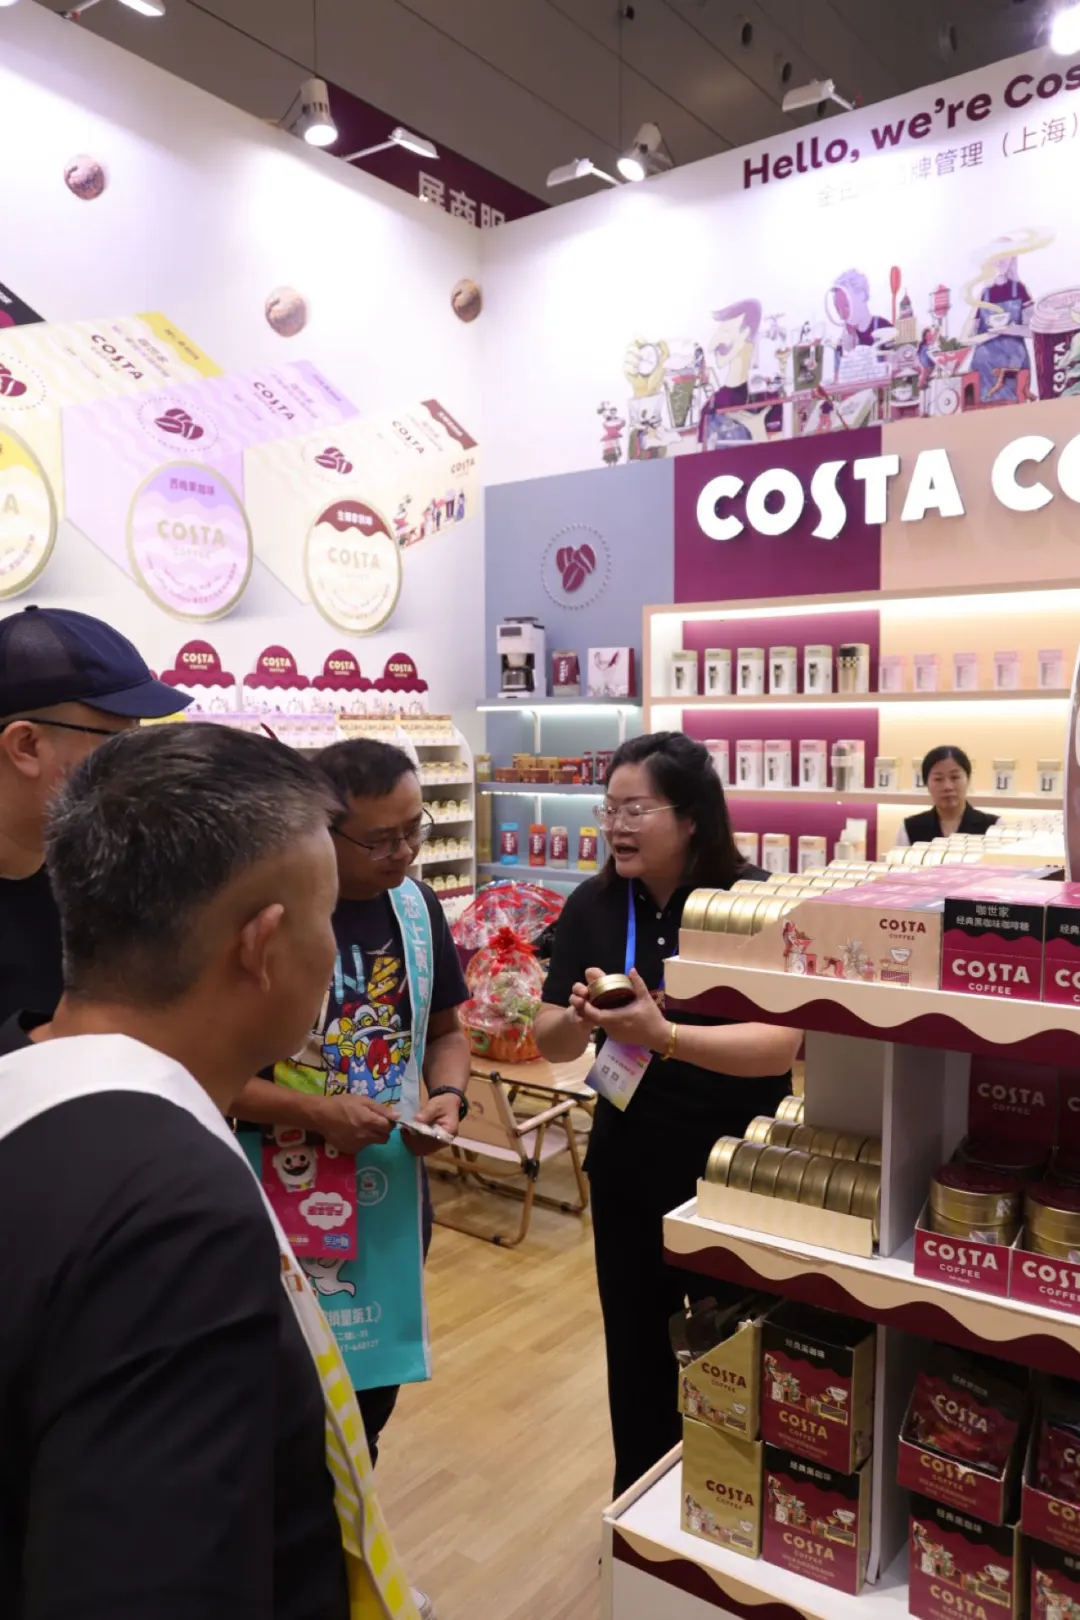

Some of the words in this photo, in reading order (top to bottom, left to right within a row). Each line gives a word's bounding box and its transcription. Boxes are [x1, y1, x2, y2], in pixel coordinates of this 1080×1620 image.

[743, 135, 860, 190] Hello,
[871, 92, 992, 150] we're
[91, 333, 144, 381] COSTA
[253, 381, 295, 421] COSTA
[696, 447, 966, 541] COSTA
[157, 519, 226, 549] COSTA
[328, 546, 382, 570] COSTA
[183, 651, 215, 665] COSTA
[262, 655, 292, 669] COSTA
[328, 659, 355, 672] COSTA
[388, 662, 413, 674] COSTA
[879, 918, 927, 934] COSTA
[888, 933, 915, 941] COFFEE
[952, 957, 1030, 984] COSTA
[968, 982, 1011, 996] COFFEE
[977, 1082, 1046, 1107] COSTA
[991, 1103, 1031, 1116] COFFEE
[923, 1240, 998, 1270] COSTA
[939, 1263, 981, 1280] COFFEE
[701, 1361, 747, 1389] COSTA
[778, 1409, 828, 1440] COSTA
[935, 1394, 988, 1433] COSTA
[920, 1453, 977, 1487] COSTA
[705, 1479, 755, 1507] COSTA
[783, 1531, 835, 1561] COSTA
[930, 1584, 987, 1620] COSTA
